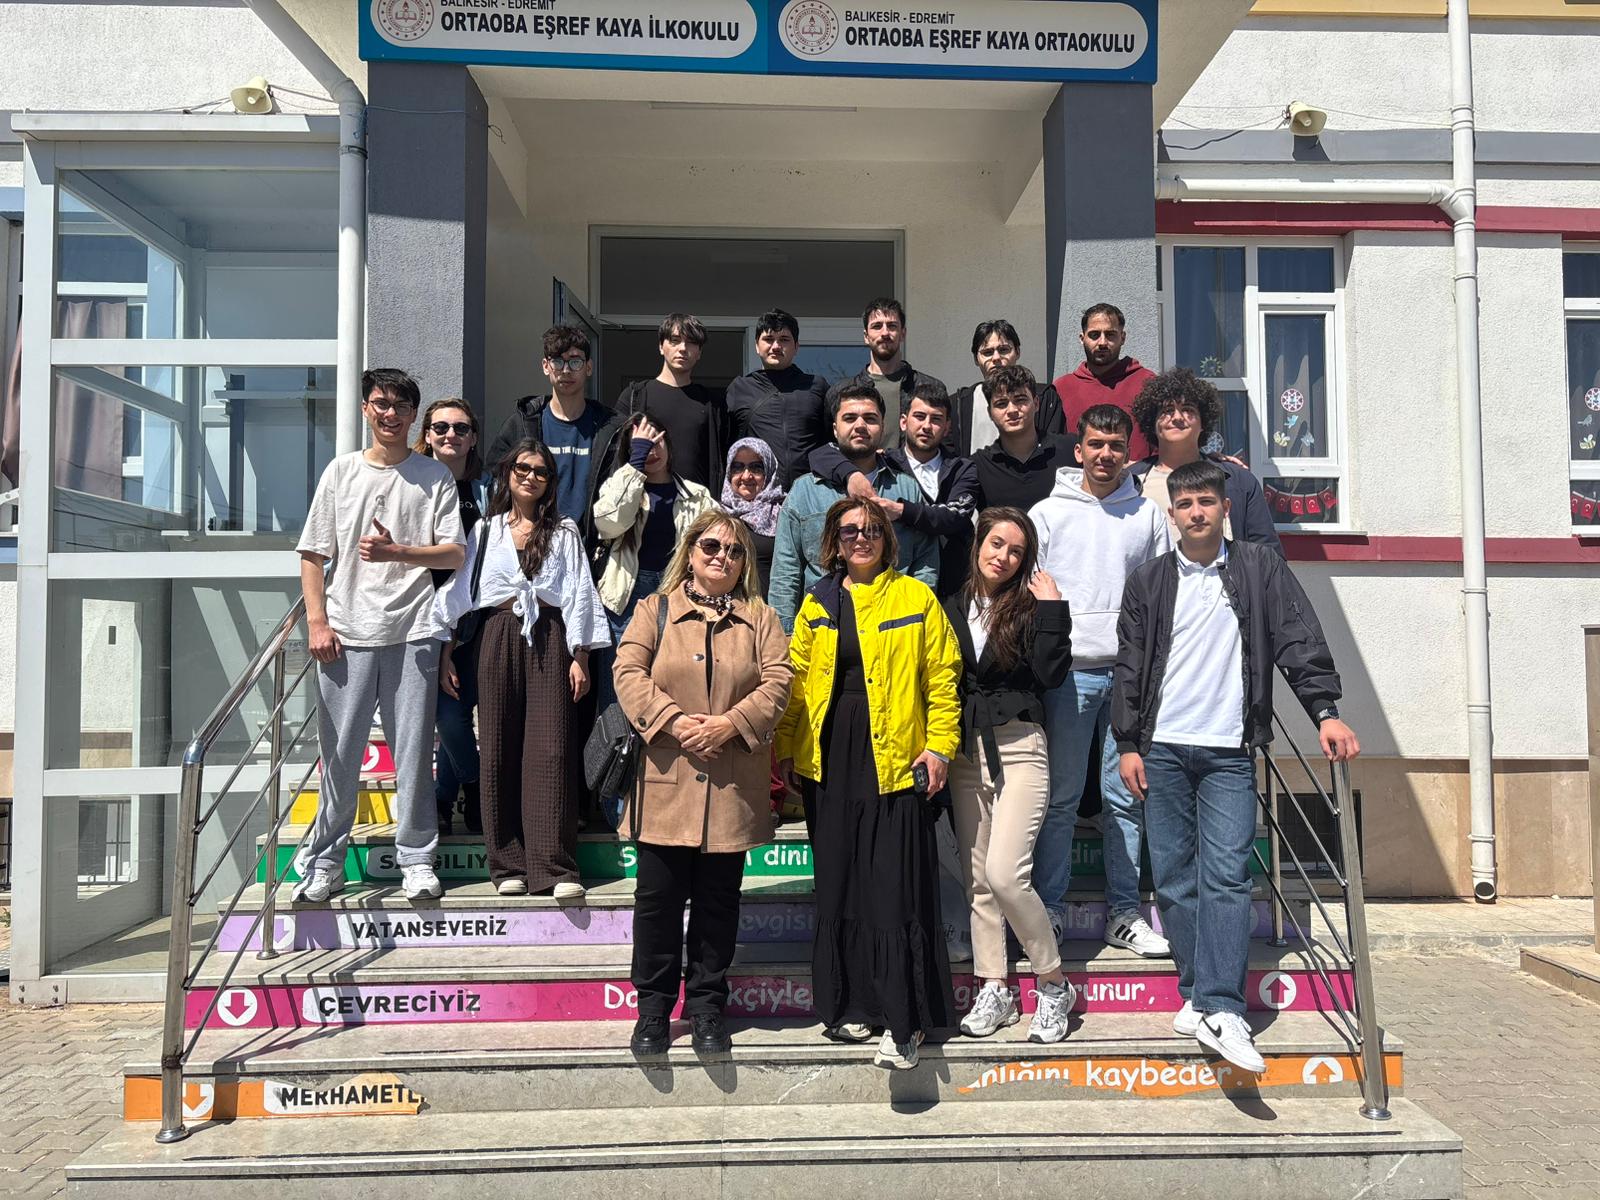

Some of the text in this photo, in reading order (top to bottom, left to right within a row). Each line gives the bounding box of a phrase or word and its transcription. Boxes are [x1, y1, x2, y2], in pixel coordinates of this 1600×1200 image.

[440, 11, 529, 34] ORTAOBA
[533, 15, 591, 40] EŞREF
[596, 17, 643, 38] KAYA
[649, 14, 739, 41] İLKOKULU
[845, 9, 901, 23] BALIKESİR
[909, 11, 955, 25] EDREMİT
[845, 26, 924, 48] ORTAOBA
[929, 28, 981, 53] EŞREF
[987, 30, 1030, 51] KAYA
[1034, 32, 1135, 54] ORTAOKULU
[352, 914, 507, 939] VATANSEVERİZ
[740, 908, 815, 938] evgisi
[319, 991, 481, 1018] ÇEVRECİYİZ
[726, 980, 813, 1013] kçiyle
[281, 1083, 425, 1108] MERHAMETL
